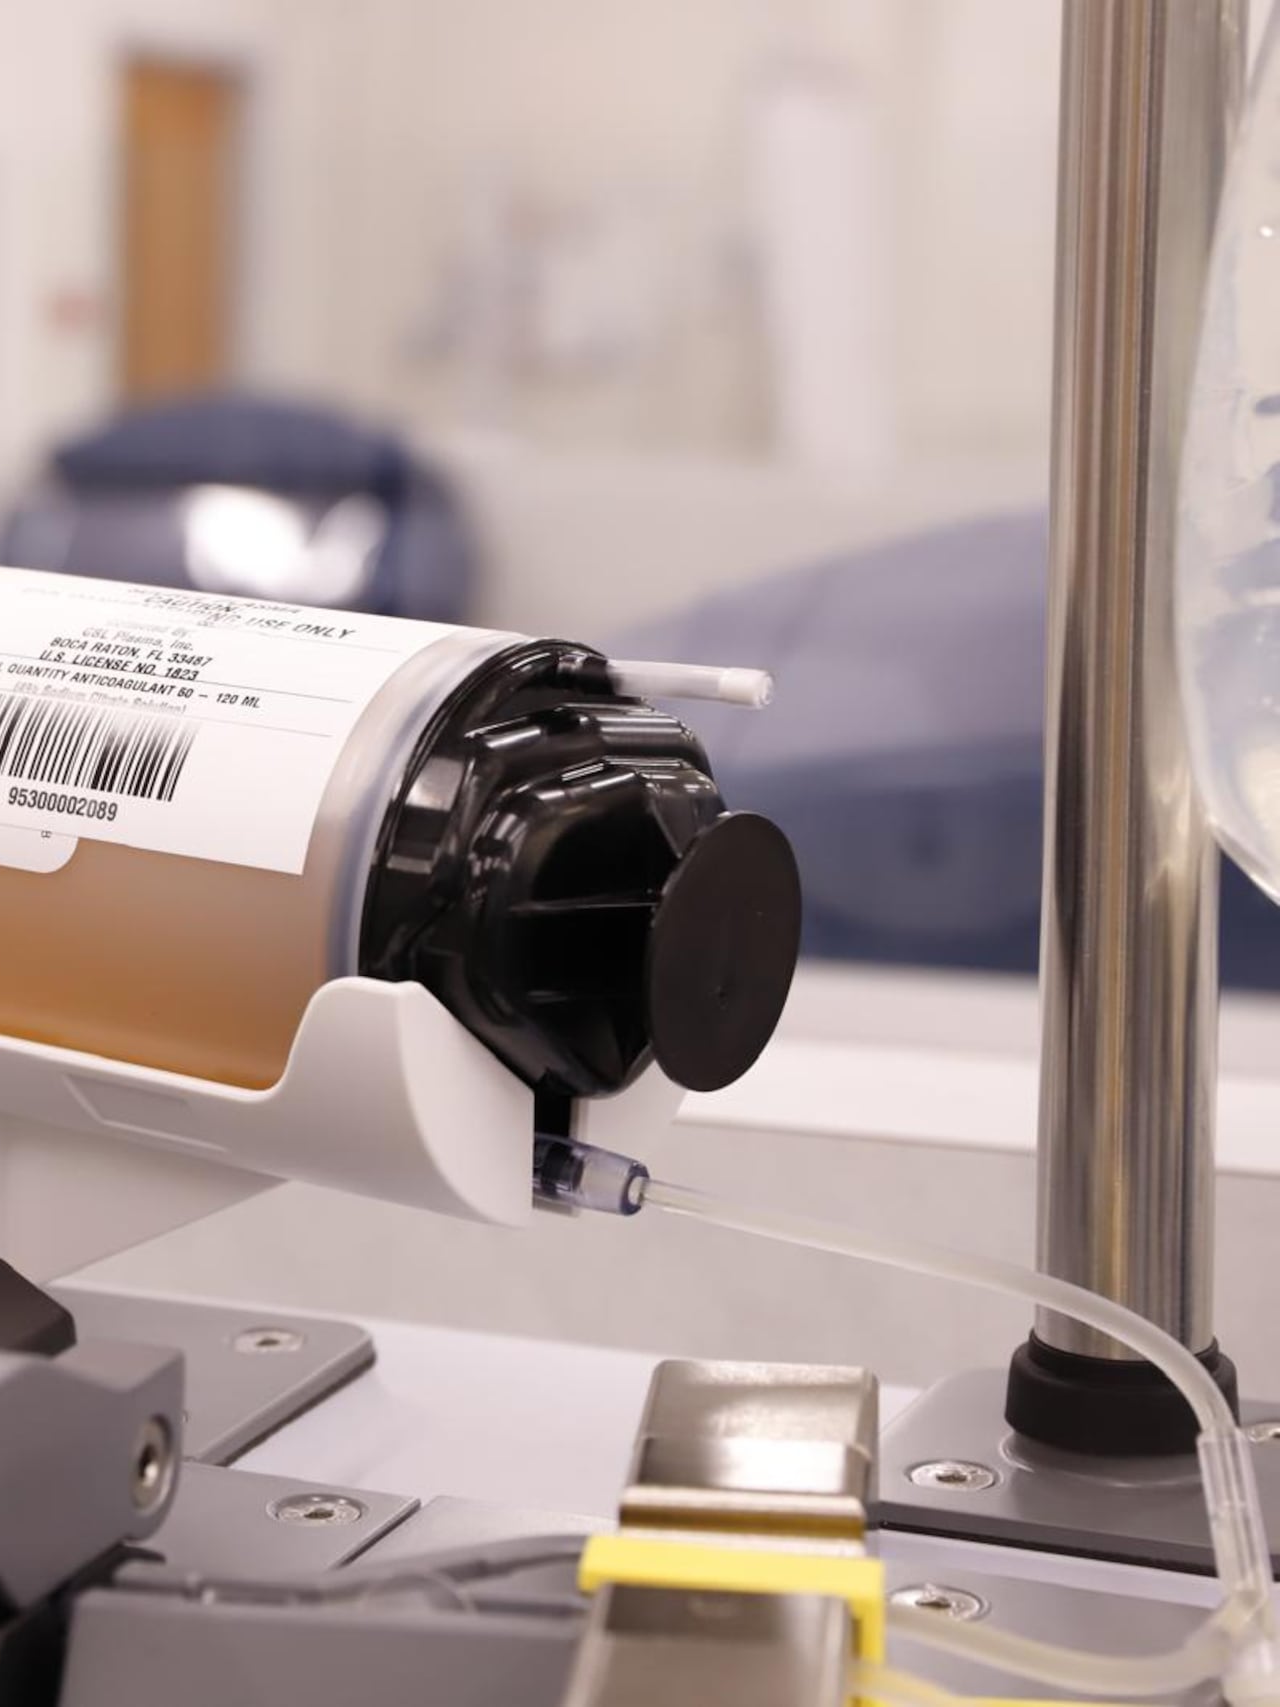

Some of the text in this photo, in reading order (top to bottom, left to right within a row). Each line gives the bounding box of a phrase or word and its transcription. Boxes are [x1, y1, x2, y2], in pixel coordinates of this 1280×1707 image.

[169, 638, 194, 651] Inc.
[245, 617, 357, 640] USE ONLY
[39, 649, 200, 682] U.S. LICENSE NO. 1823
[49, 636, 213, 668] BOCA RATON, FL 33487
[7, 663, 71, 681] QUANTITY
[70, 672, 175, 696] ANTICOAGULANT
[215, 692, 239, 706] 120
[240, 695, 262, 709] ML
[8, 786, 119, 822] 95300002089
